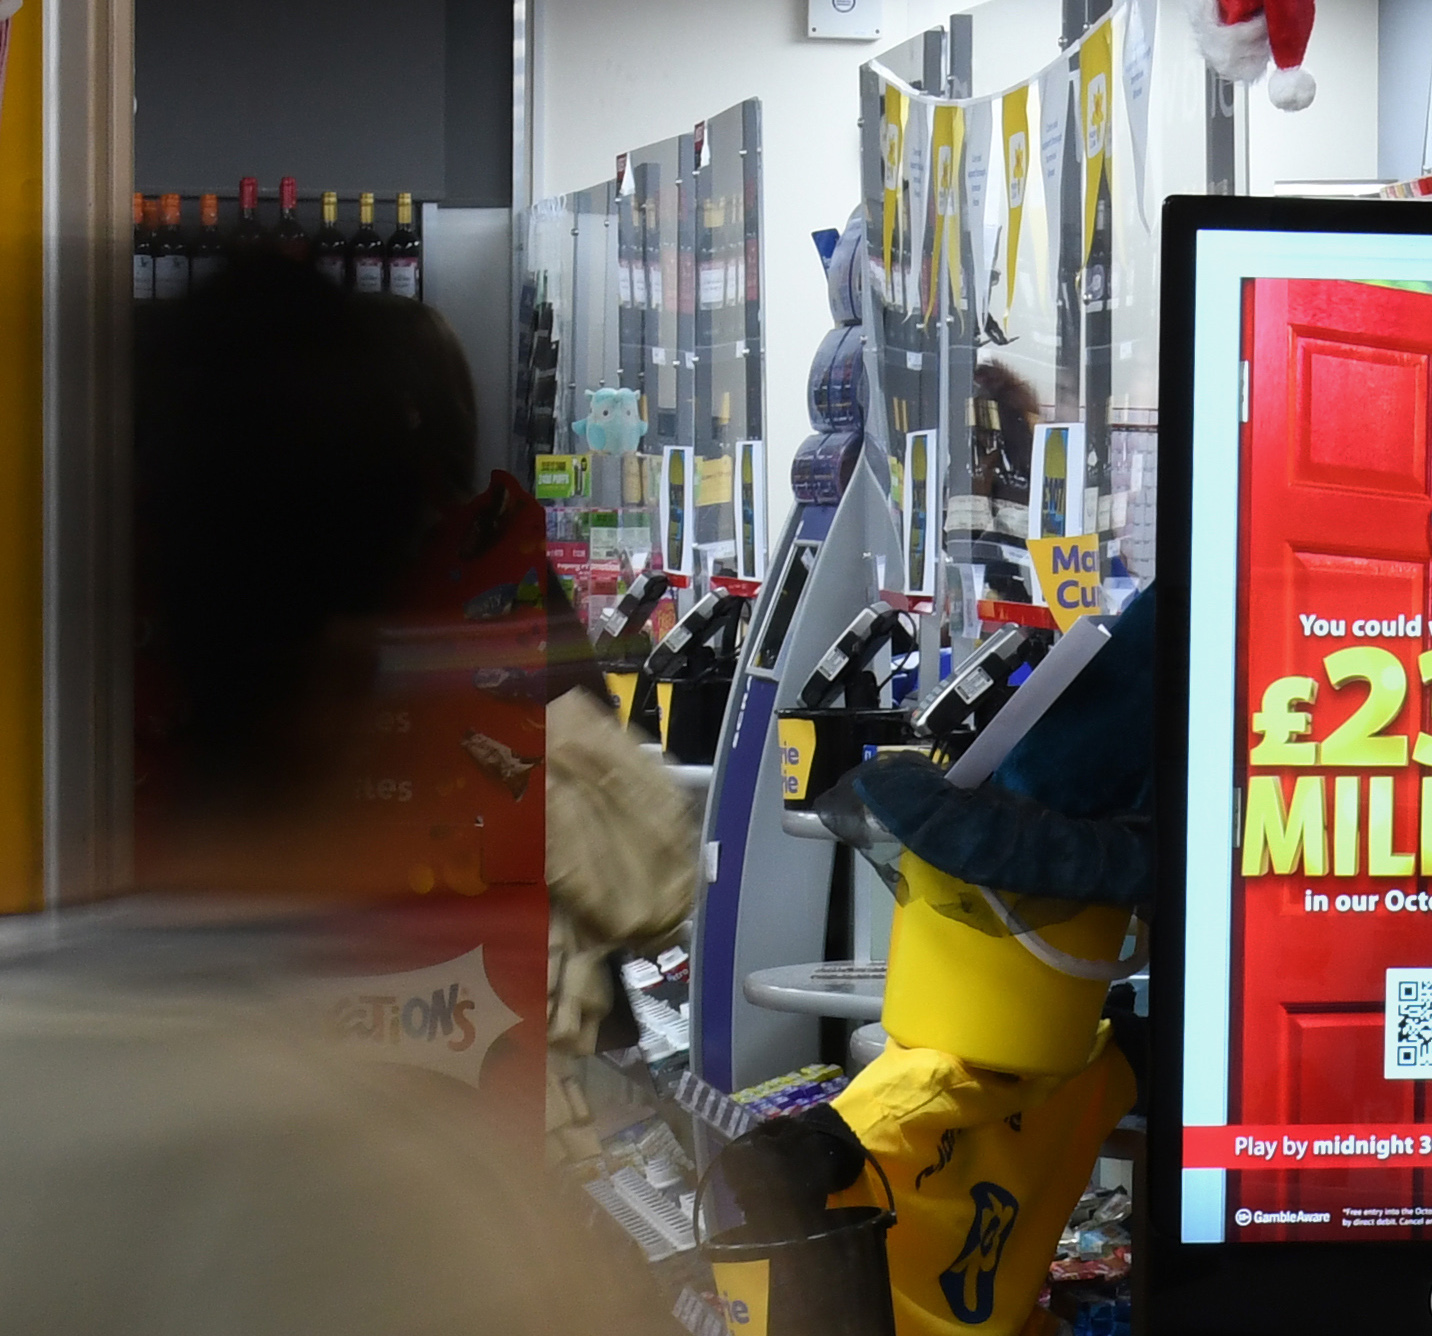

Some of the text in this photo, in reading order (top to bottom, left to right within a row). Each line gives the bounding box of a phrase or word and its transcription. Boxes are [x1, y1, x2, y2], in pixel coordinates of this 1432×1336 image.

[1299, 615, 1345, 637] You
[1352, 615, 1422, 638] could
[1305, 889, 1328, 912] in
[1335, 893, 1379, 912] our
[1235, 1136, 1277, 1160] Play
[1282, 1135, 1308, 1159] by
[1314, 1135, 1414, 1160] midnight
[1253, 1210, 1331, 1224] GambleAware
